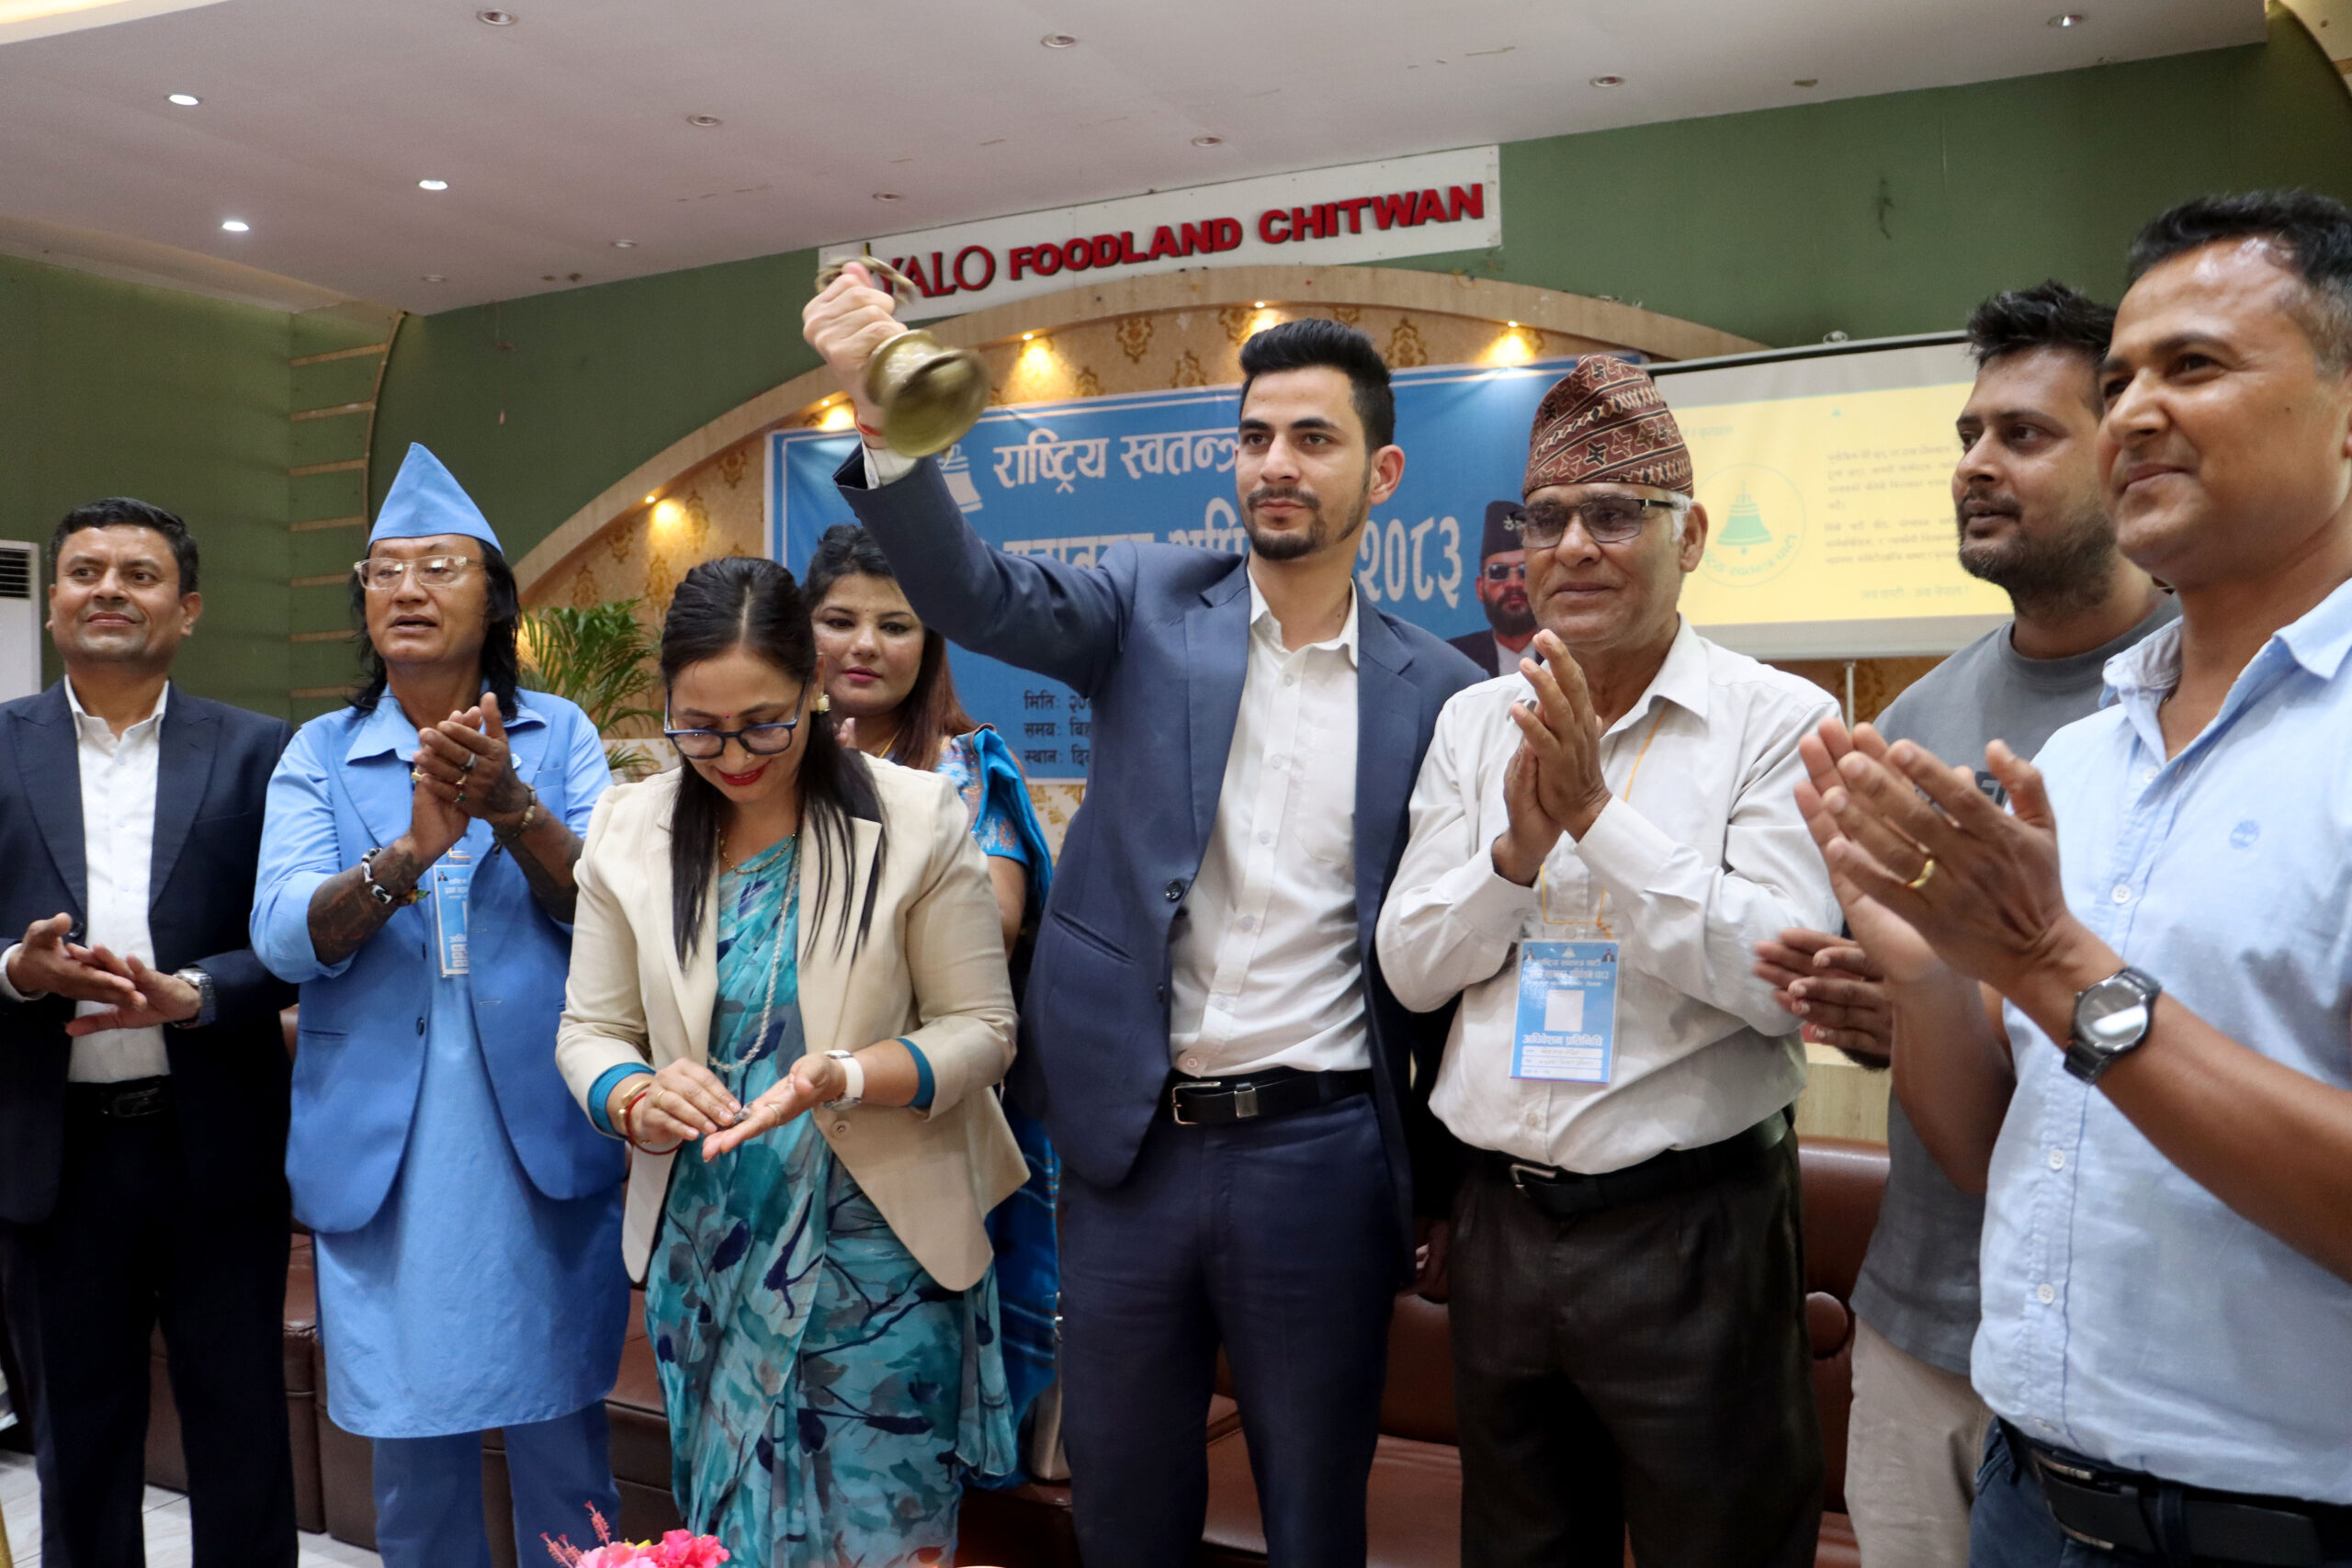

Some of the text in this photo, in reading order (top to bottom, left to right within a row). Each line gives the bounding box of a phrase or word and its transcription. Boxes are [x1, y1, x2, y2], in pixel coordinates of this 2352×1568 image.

[1009, 217, 1243, 280] FOODLAND
[1258, 183, 1485, 244] CHITWAN
[992, 428, 1110, 494] राष्ट्रिय
[1358, 516, 1463, 610] २०८३
